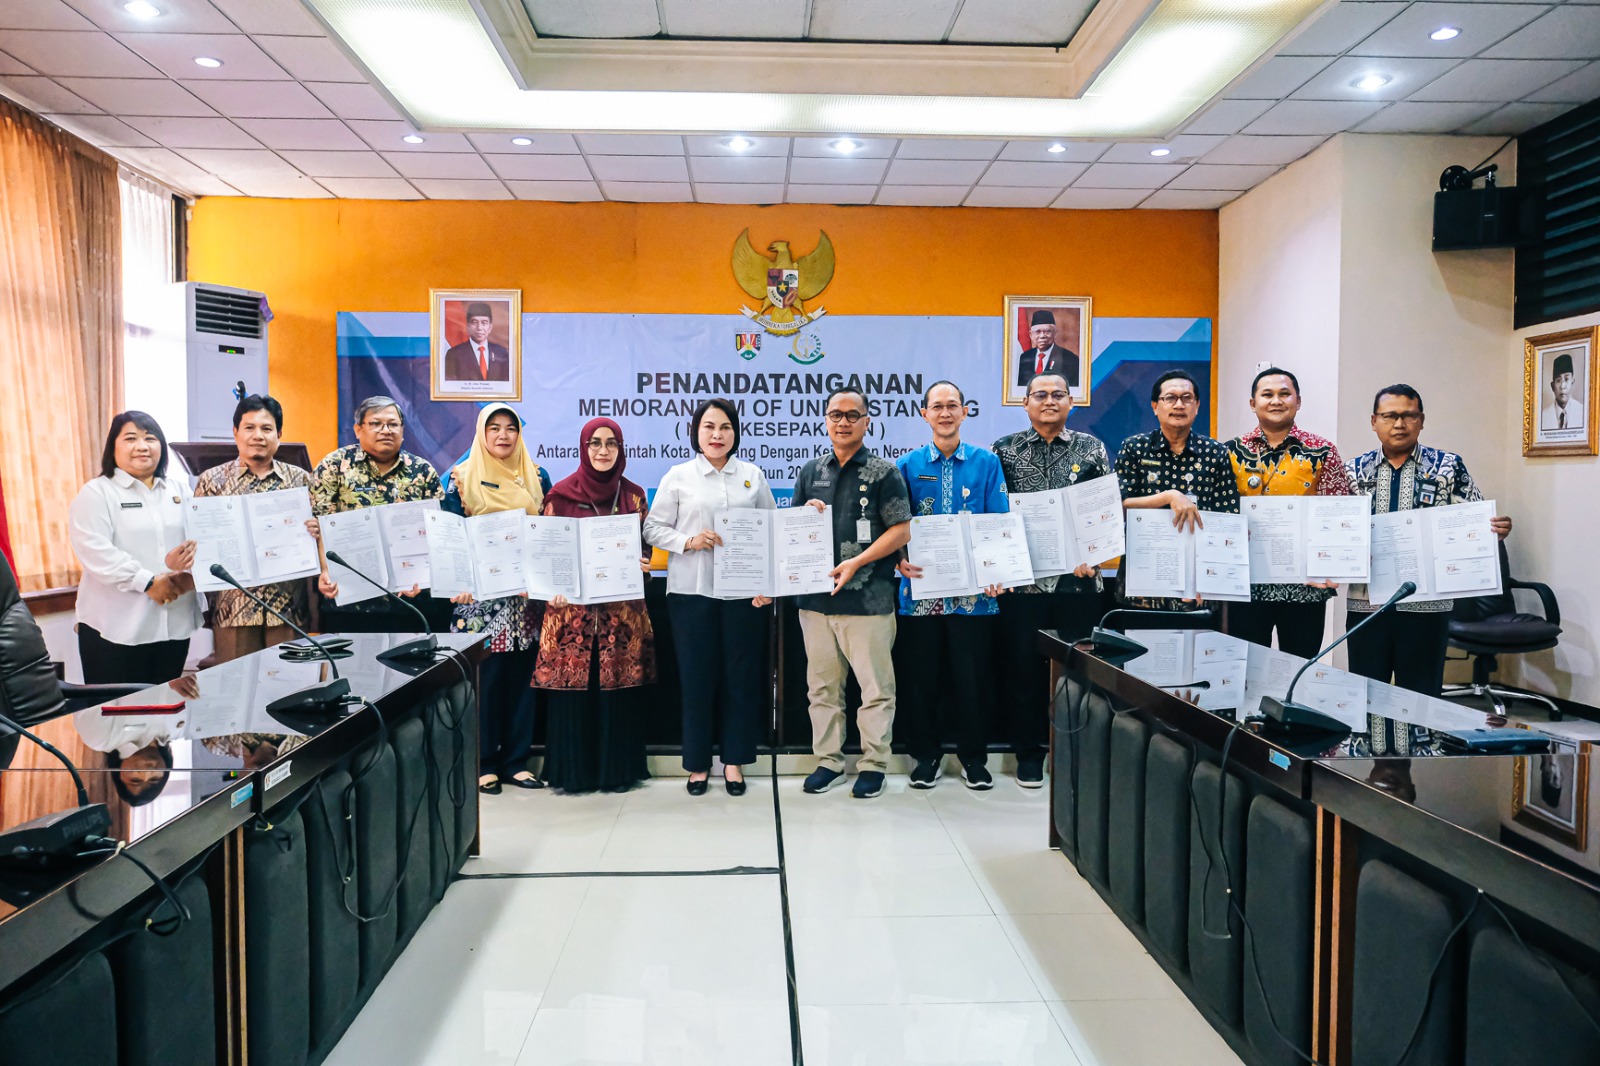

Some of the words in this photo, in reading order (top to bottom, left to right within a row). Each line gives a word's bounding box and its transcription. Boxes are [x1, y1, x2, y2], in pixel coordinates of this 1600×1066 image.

[637, 372, 923, 395] PENANDATANGANAN
[752, 399, 782, 417] OF
[536, 443, 579, 459] Antara
[660, 444, 690, 459] Kota
[760, 444, 809, 462] Dengan
